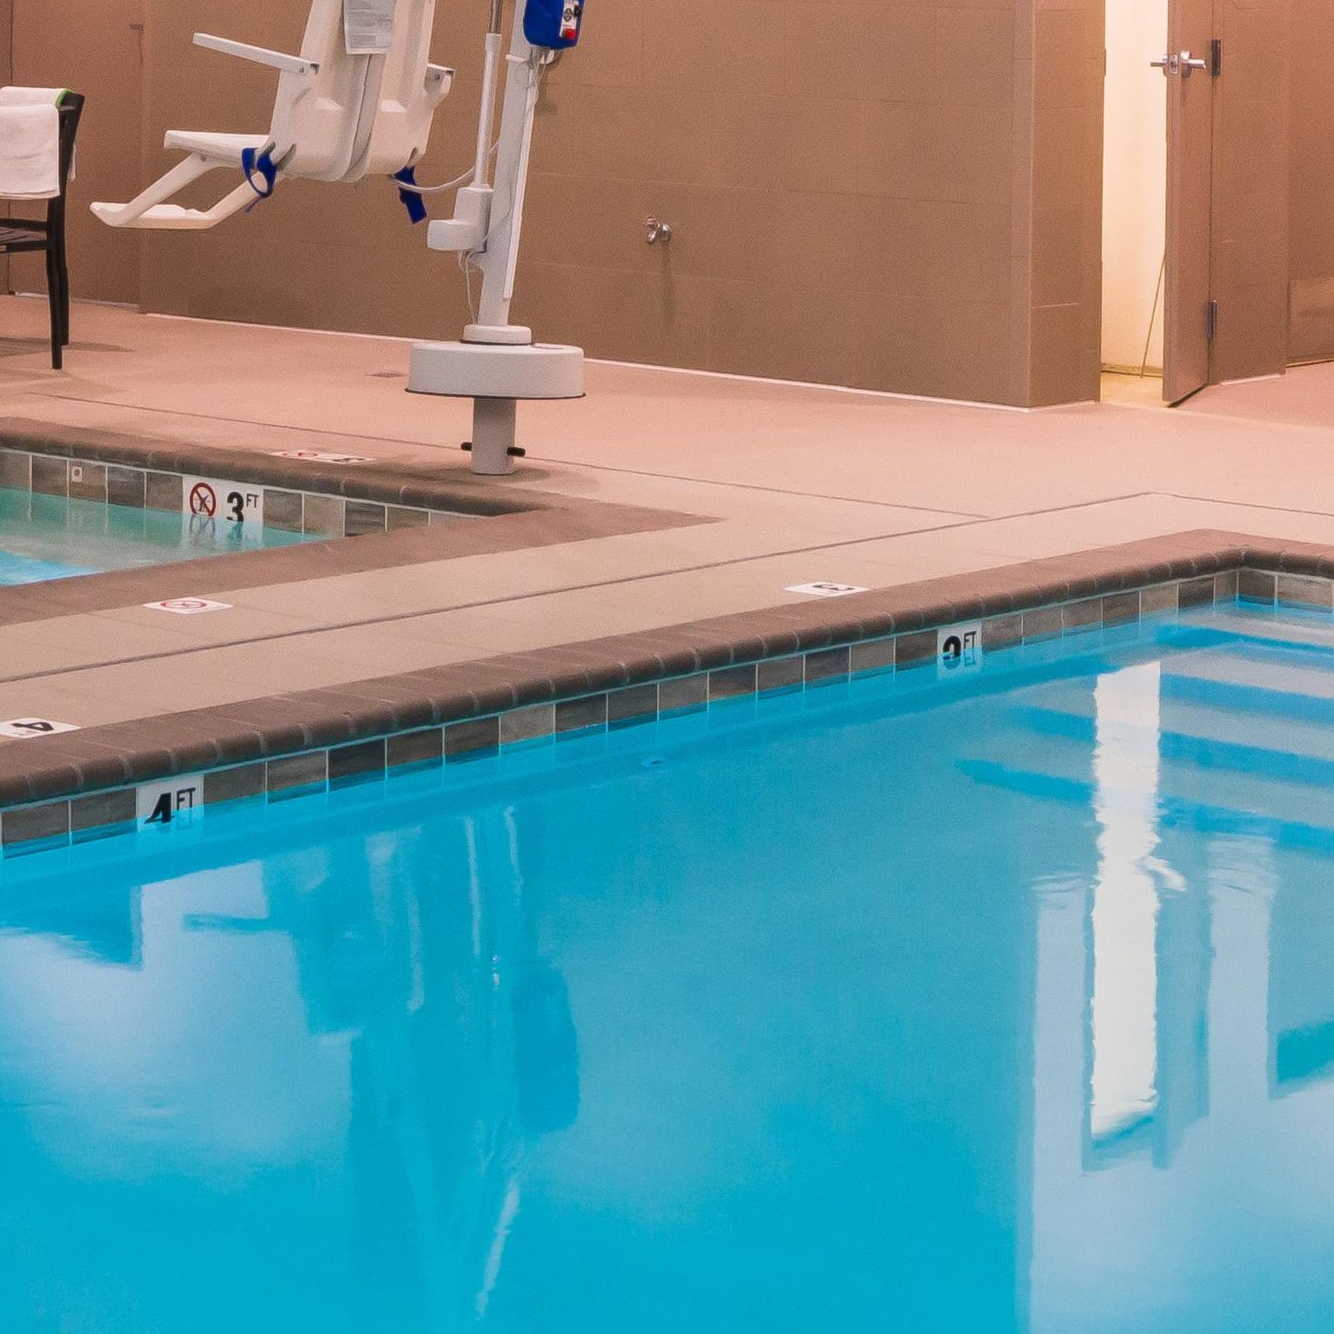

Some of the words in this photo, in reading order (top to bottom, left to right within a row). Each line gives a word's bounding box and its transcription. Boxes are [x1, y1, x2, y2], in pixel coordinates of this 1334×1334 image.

[246, 493, 259, 508] FT
[963, 631, 977, 650] FT
[176, 787, 196, 811] FT
